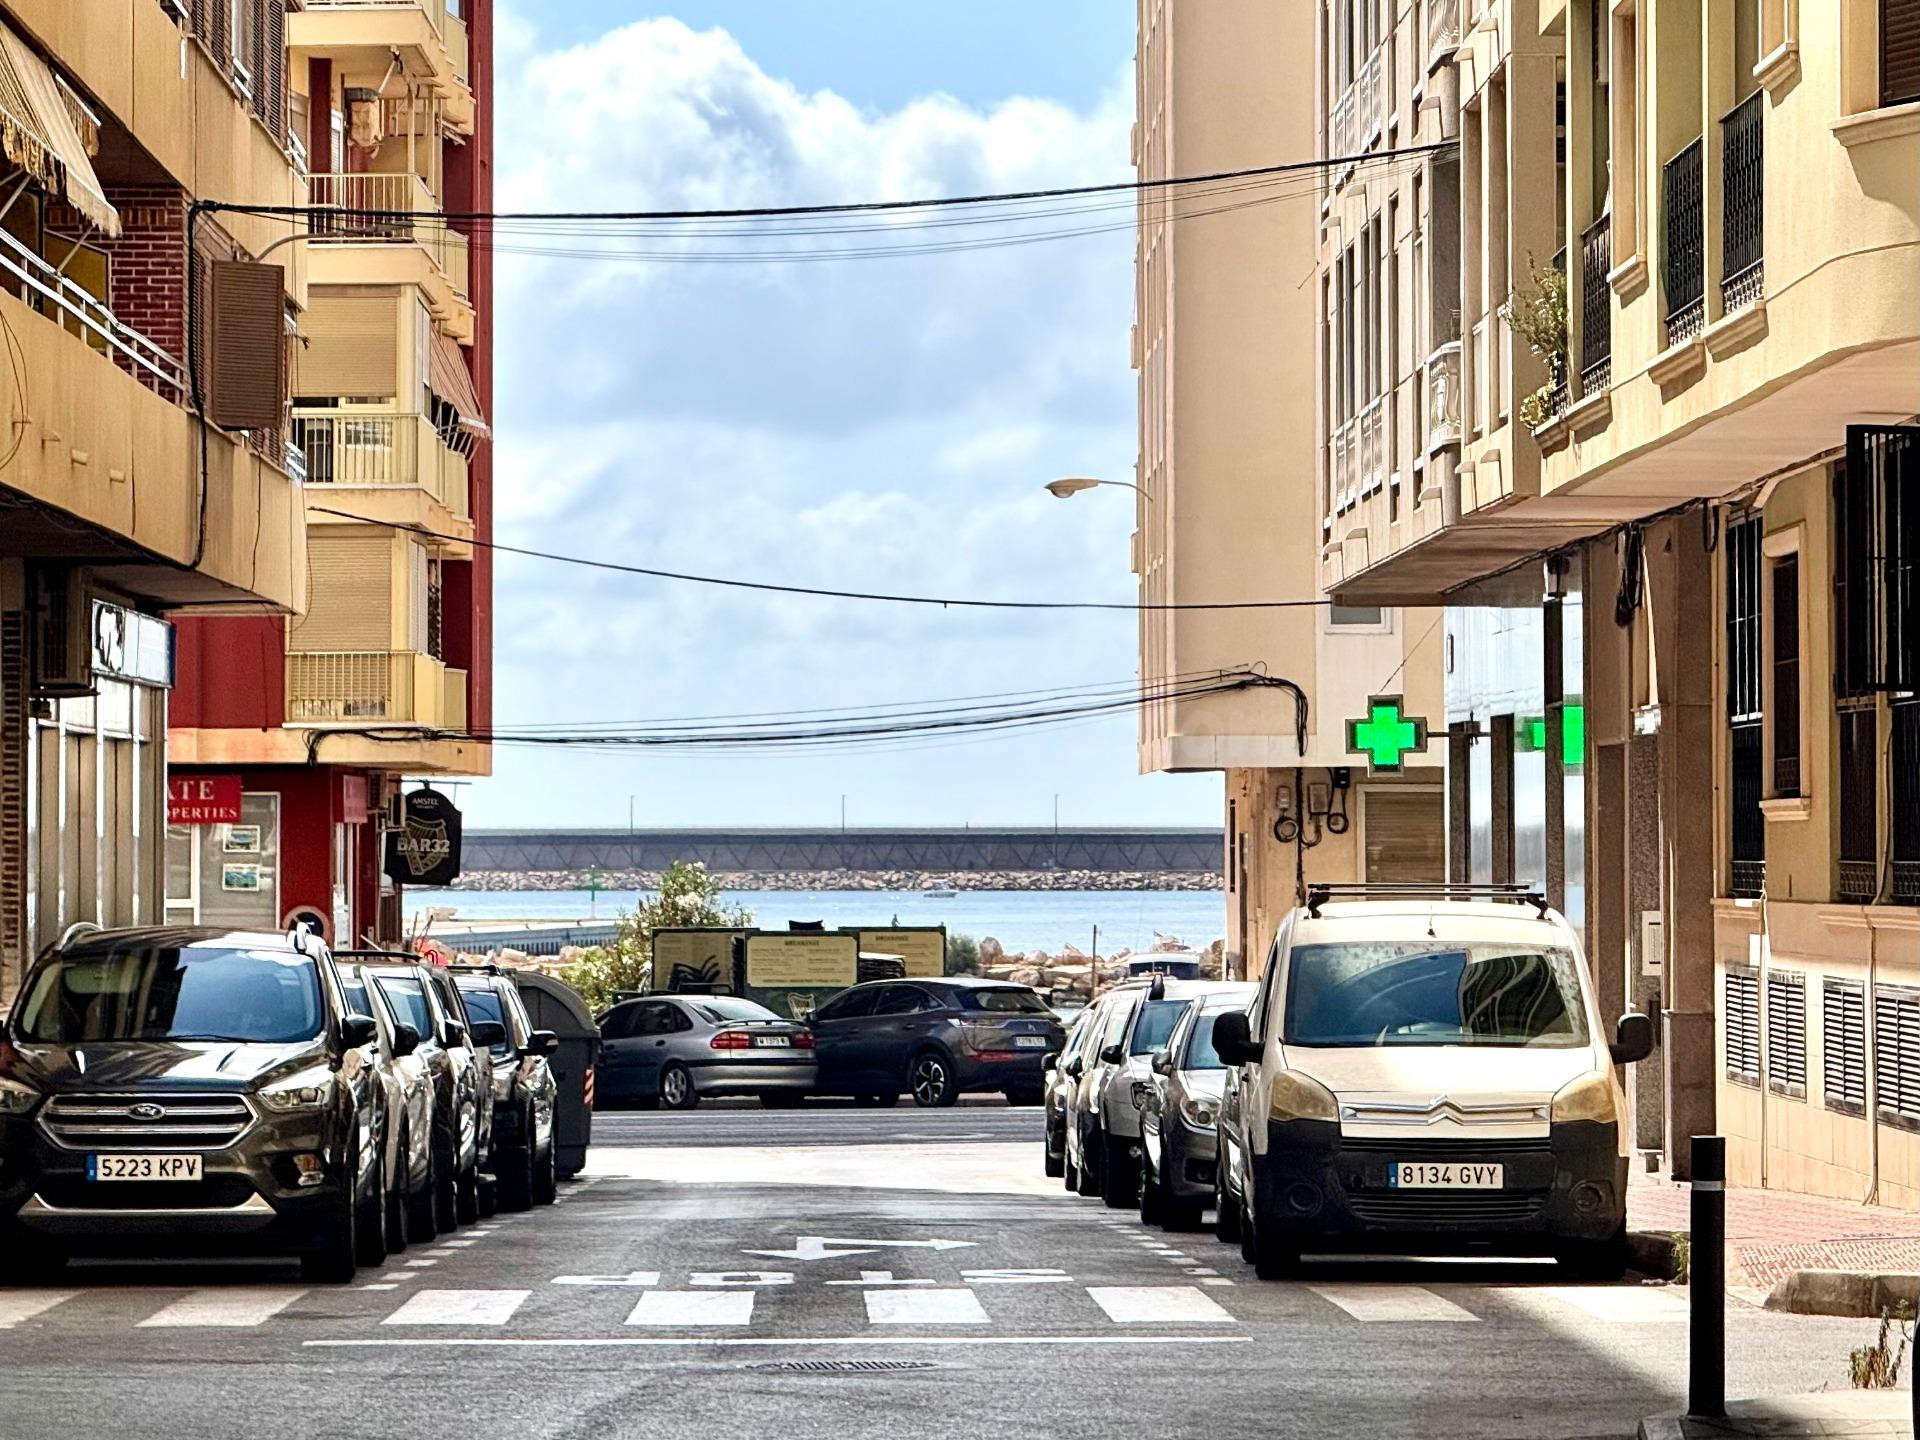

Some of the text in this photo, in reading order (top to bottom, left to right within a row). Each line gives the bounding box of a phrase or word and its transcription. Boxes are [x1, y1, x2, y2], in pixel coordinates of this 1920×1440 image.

[167, 807, 238, 819] PERTIES
[397, 837, 450, 853] BAR32
[102, 1159, 196, 1177] 5223 KPV
[1402, 1166, 1496, 1184] 8134 GVY
